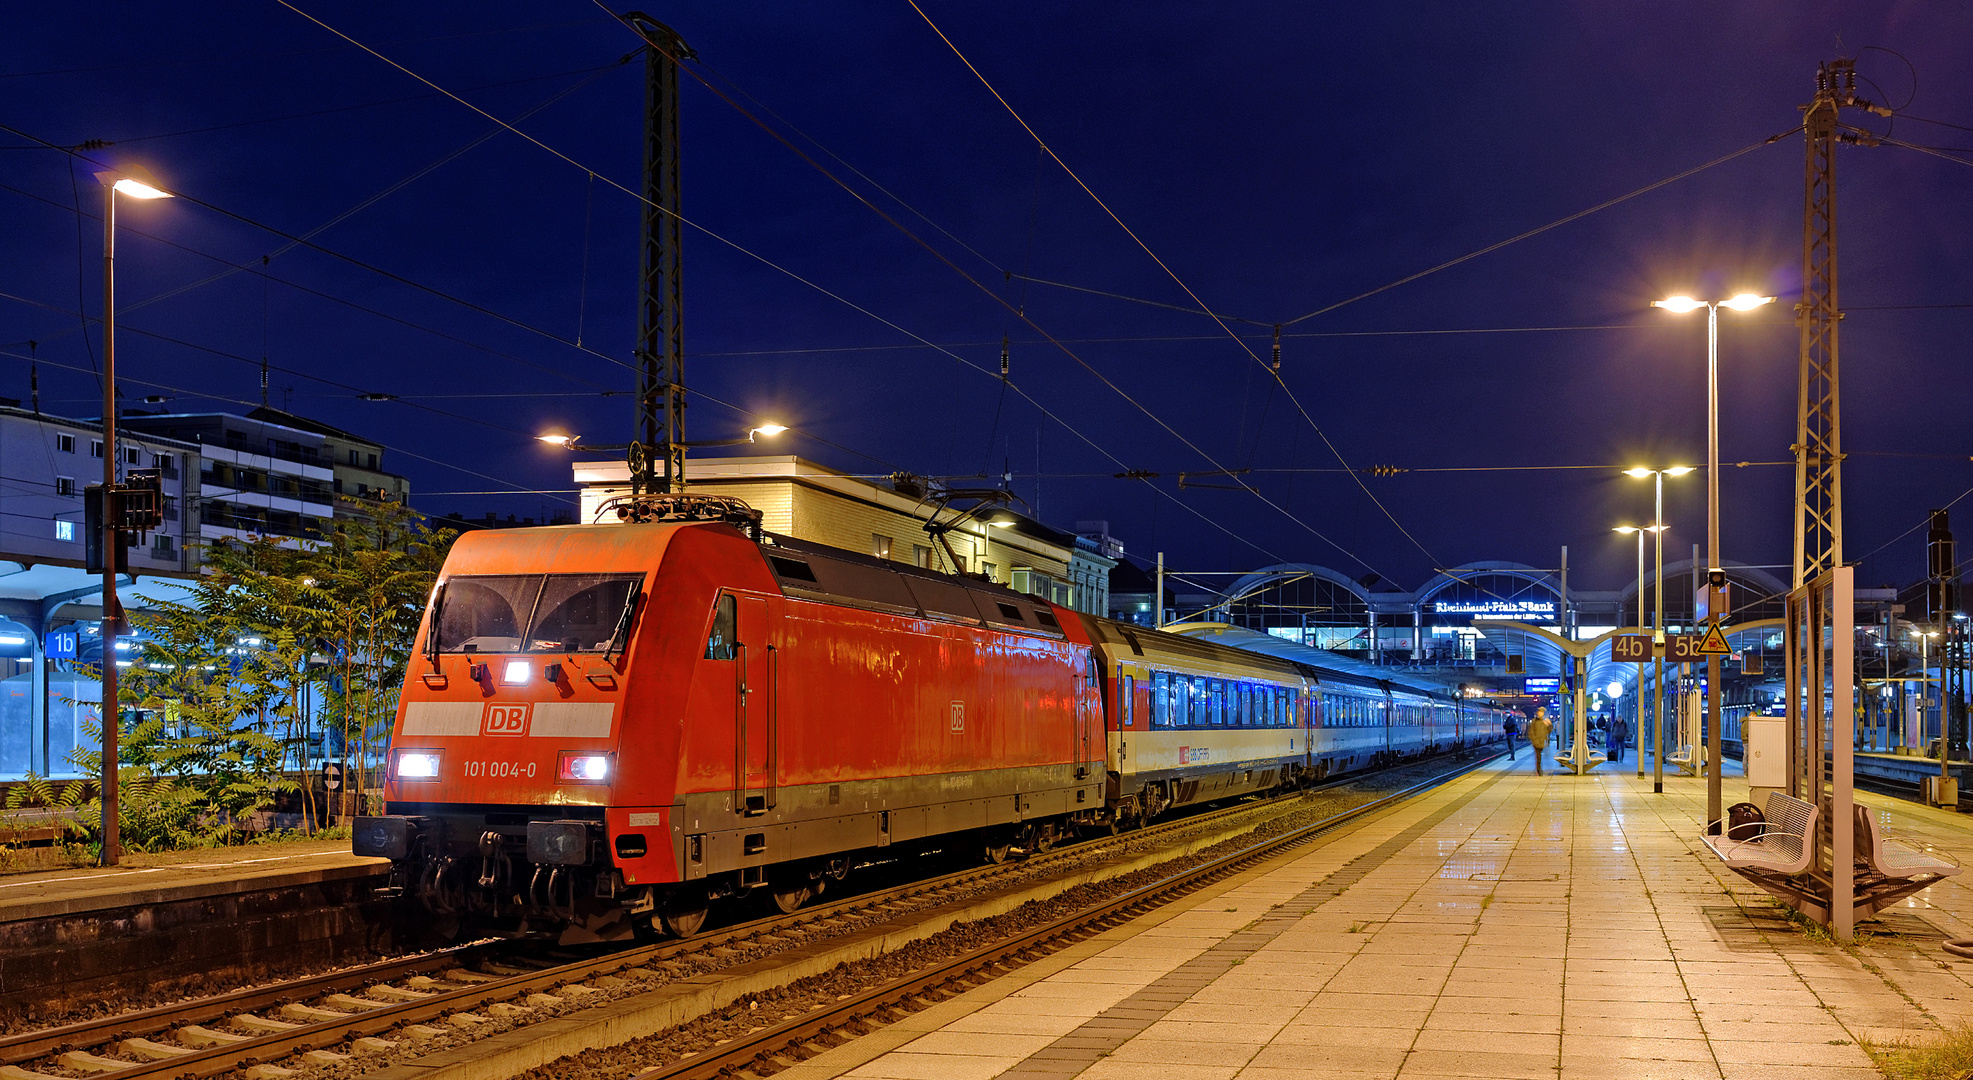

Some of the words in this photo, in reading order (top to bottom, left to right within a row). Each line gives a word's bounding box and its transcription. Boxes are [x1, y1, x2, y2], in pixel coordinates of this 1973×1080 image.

[1436, 602, 1519, 612] Rheinland-Pfalz
[1527, 602, 1554, 612] Bank
[55, 633, 74, 652] 1b
[1615, 636, 1644, 657] 4b
[1675, 636, 1701, 657] 5b
[489, 708, 523, 731] DB
[952, 706, 963, 728] DB
[464, 761, 486, 777] 101
[490, 761, 537, 778] 004-0
